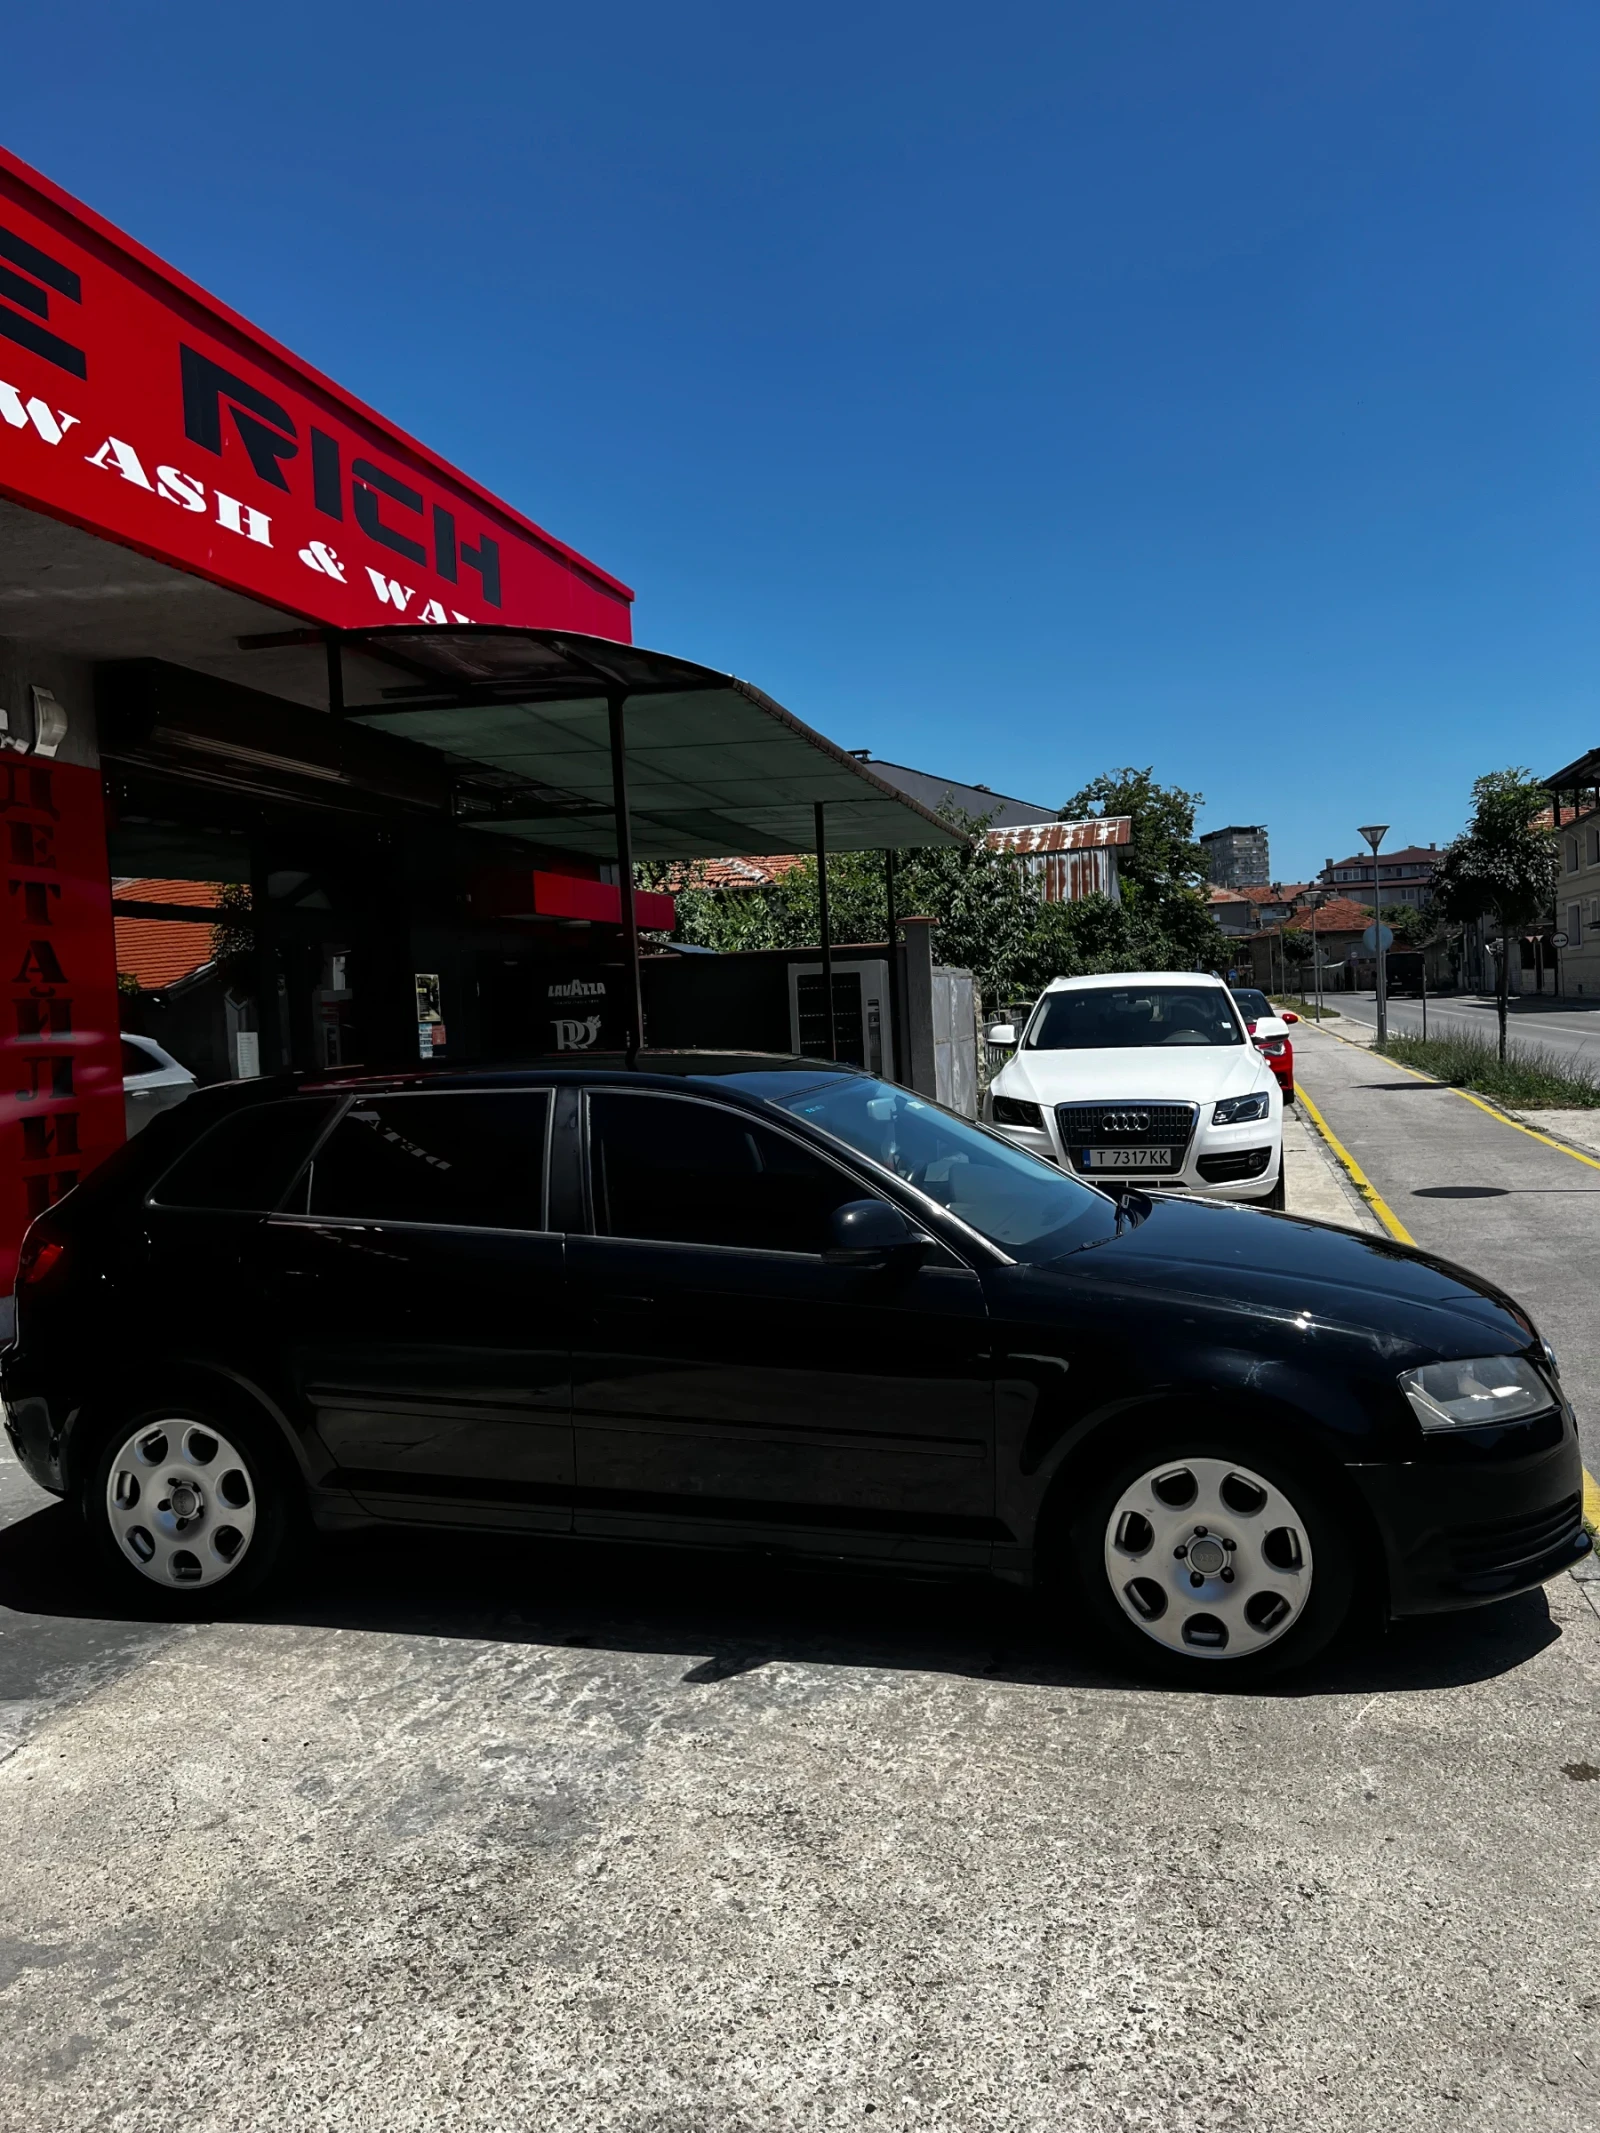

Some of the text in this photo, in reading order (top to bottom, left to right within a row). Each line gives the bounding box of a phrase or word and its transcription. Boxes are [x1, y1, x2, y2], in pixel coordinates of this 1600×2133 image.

[0, 380, 274, 548] WASH
[298, 540, 348, 584] &
[179, 341, 502, 609] RICH
[547, 979, 607, 998] LAVAZZA
[1096, 1151, 1106, 1165] T
